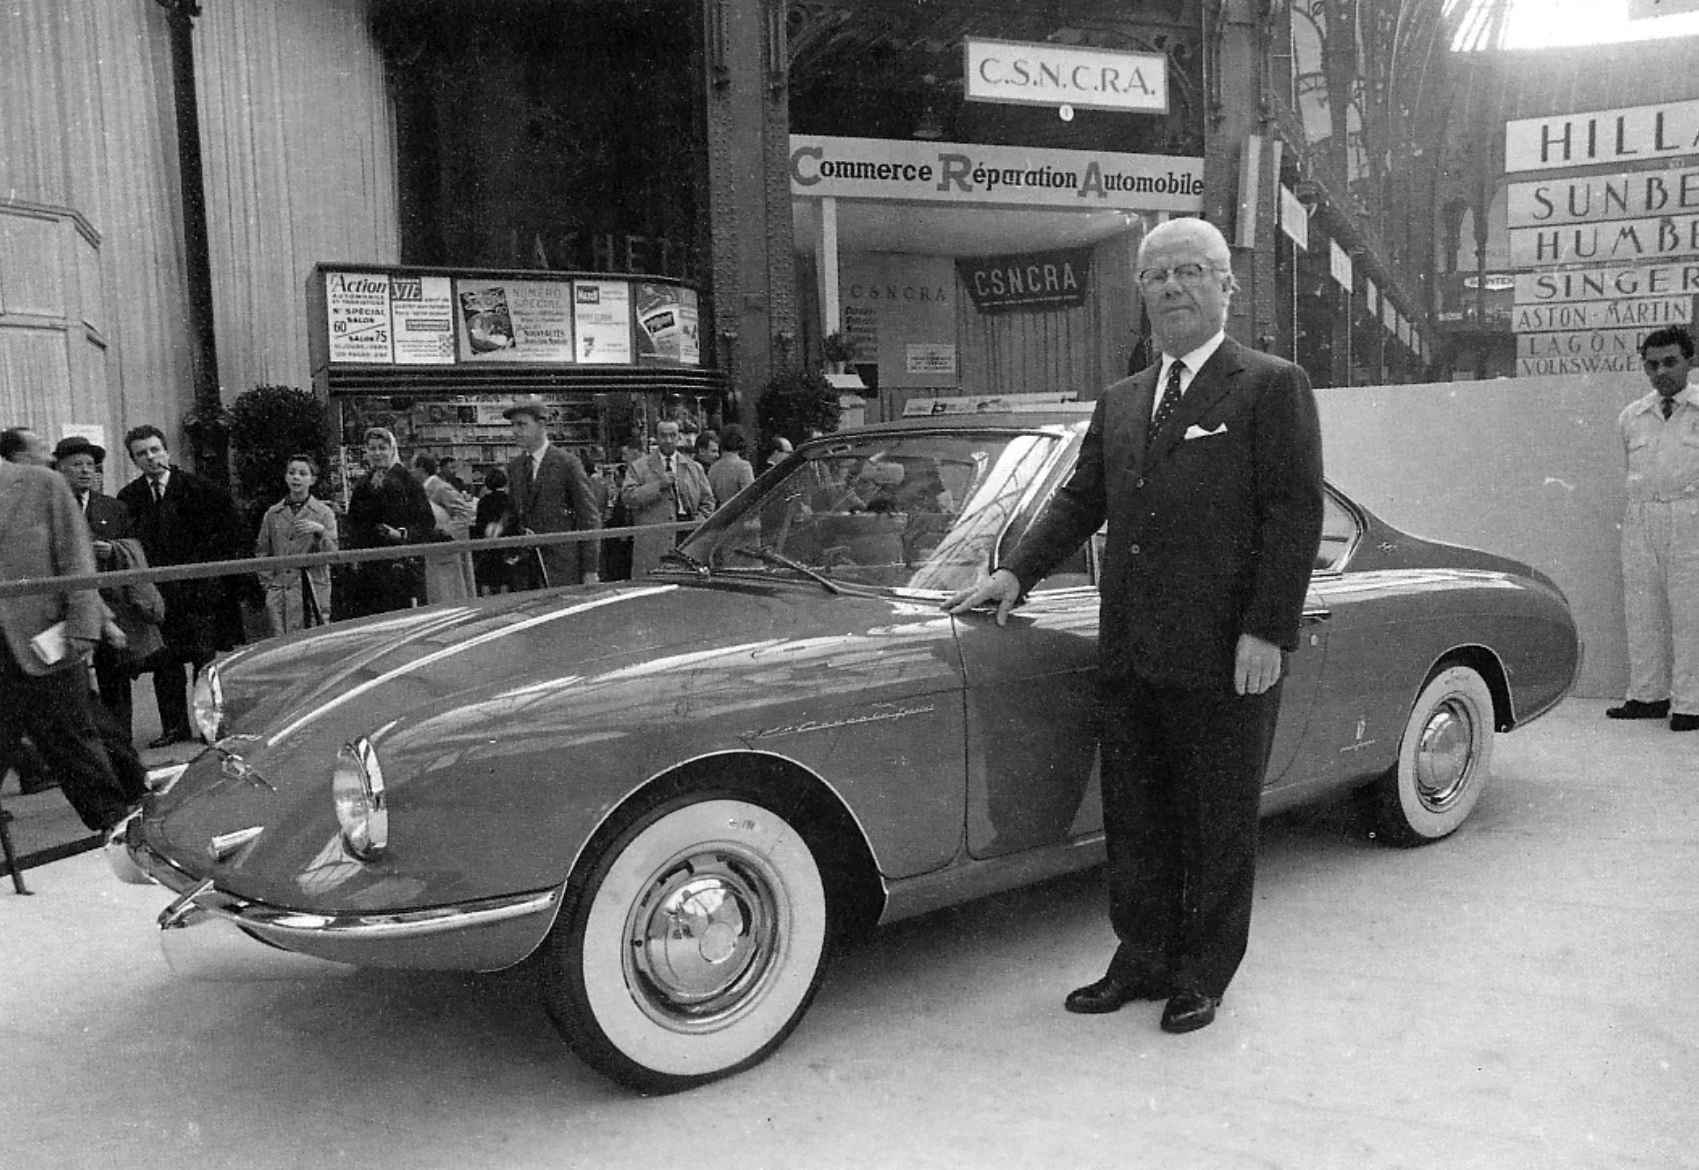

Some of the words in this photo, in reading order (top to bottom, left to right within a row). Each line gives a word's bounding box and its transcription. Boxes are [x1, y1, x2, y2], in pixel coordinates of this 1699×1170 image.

[979, 57, 1157, 96] C.S.N.C.R.A.
[1541, 111, 1699, 162] HILL
[790, 146, 932, 186] Commerce
[936, 152, 1077, 192] Réparation
[1077, 161, 1204, 198] Automobile
[1532, 172, 1699, 220] SUNBE
[974, 262, 1078, 296] CSNCRA
[1535, 266, 1699, 299] SINGER
[333, 320, 347, 333] 60
[374, 330, 387, 343] 75
